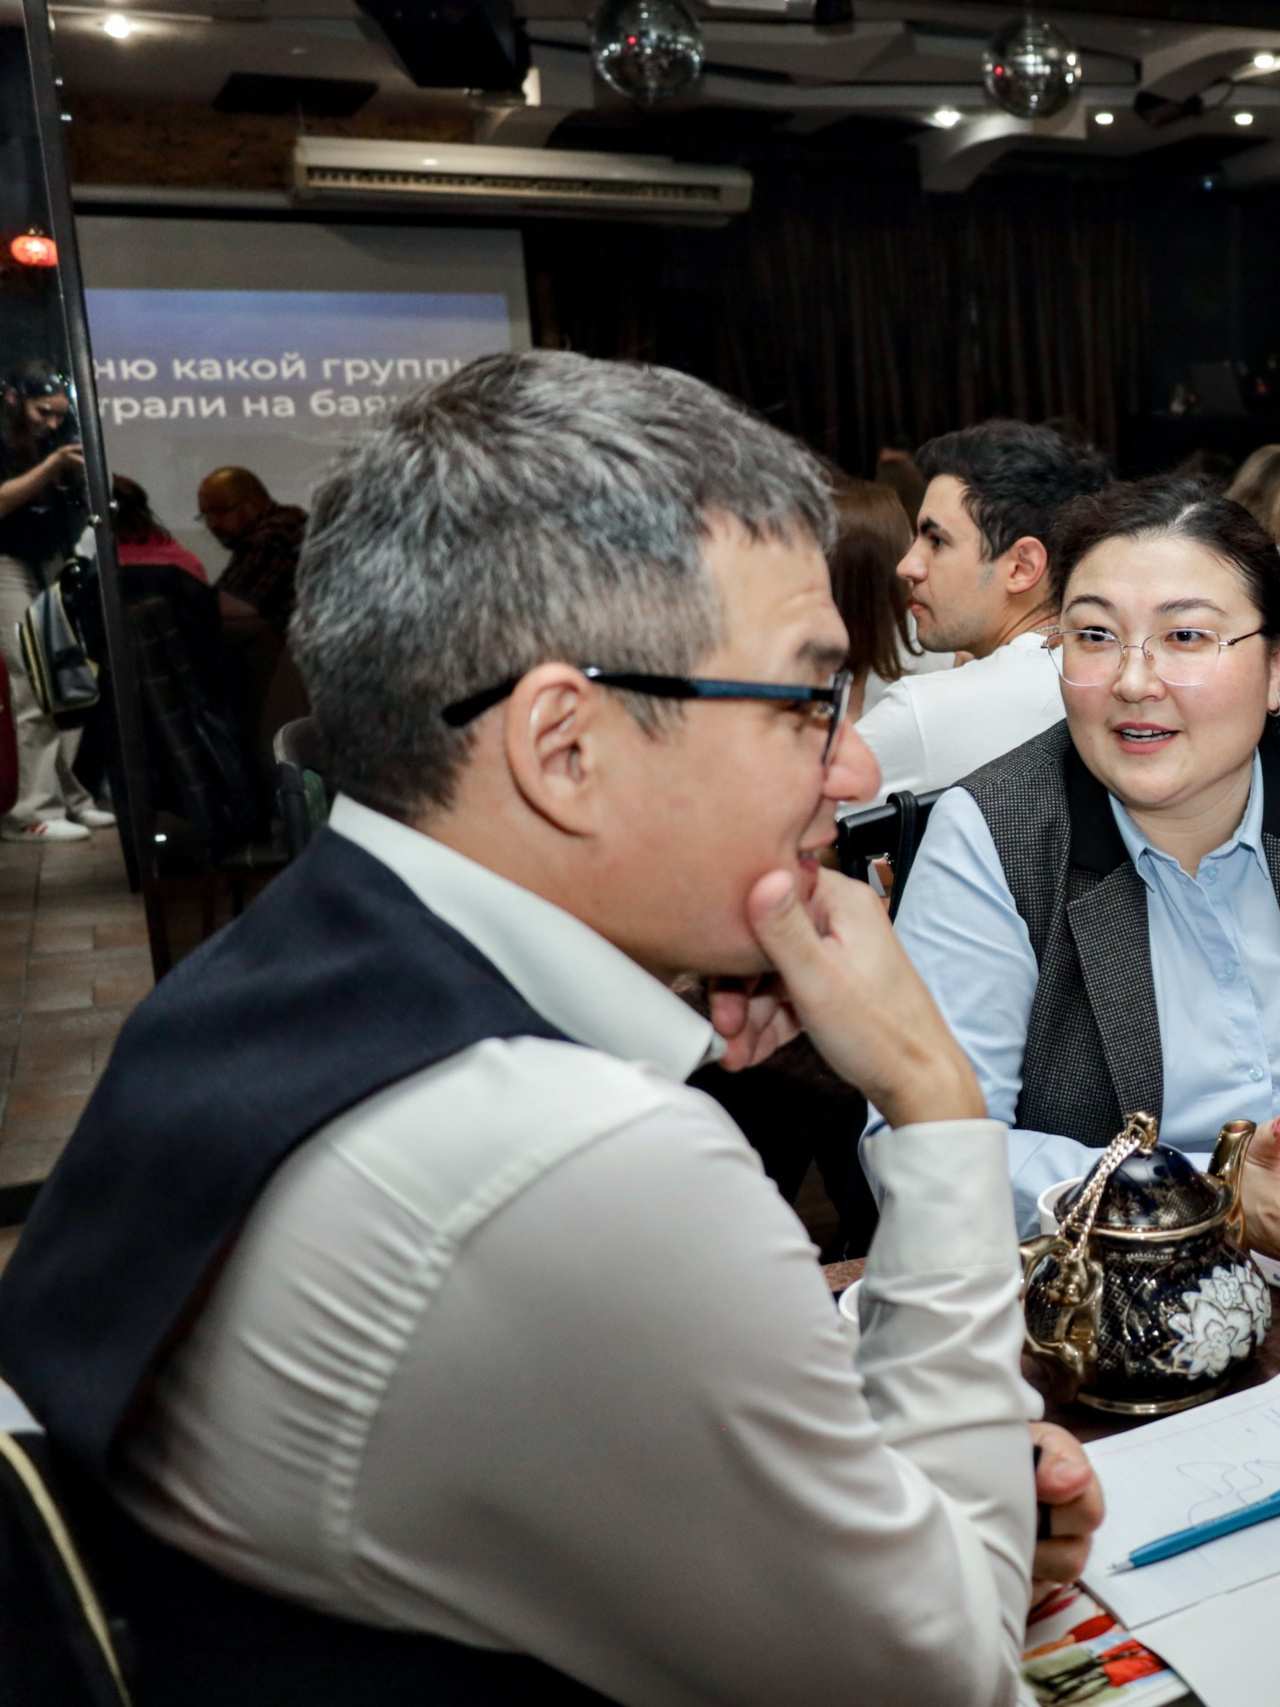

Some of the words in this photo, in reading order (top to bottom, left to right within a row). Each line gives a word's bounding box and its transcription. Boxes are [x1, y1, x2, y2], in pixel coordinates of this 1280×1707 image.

[173, 351, 307, 381] какой
[242, 397, 295, 418] на
[310, 388, 397, 418] бая
